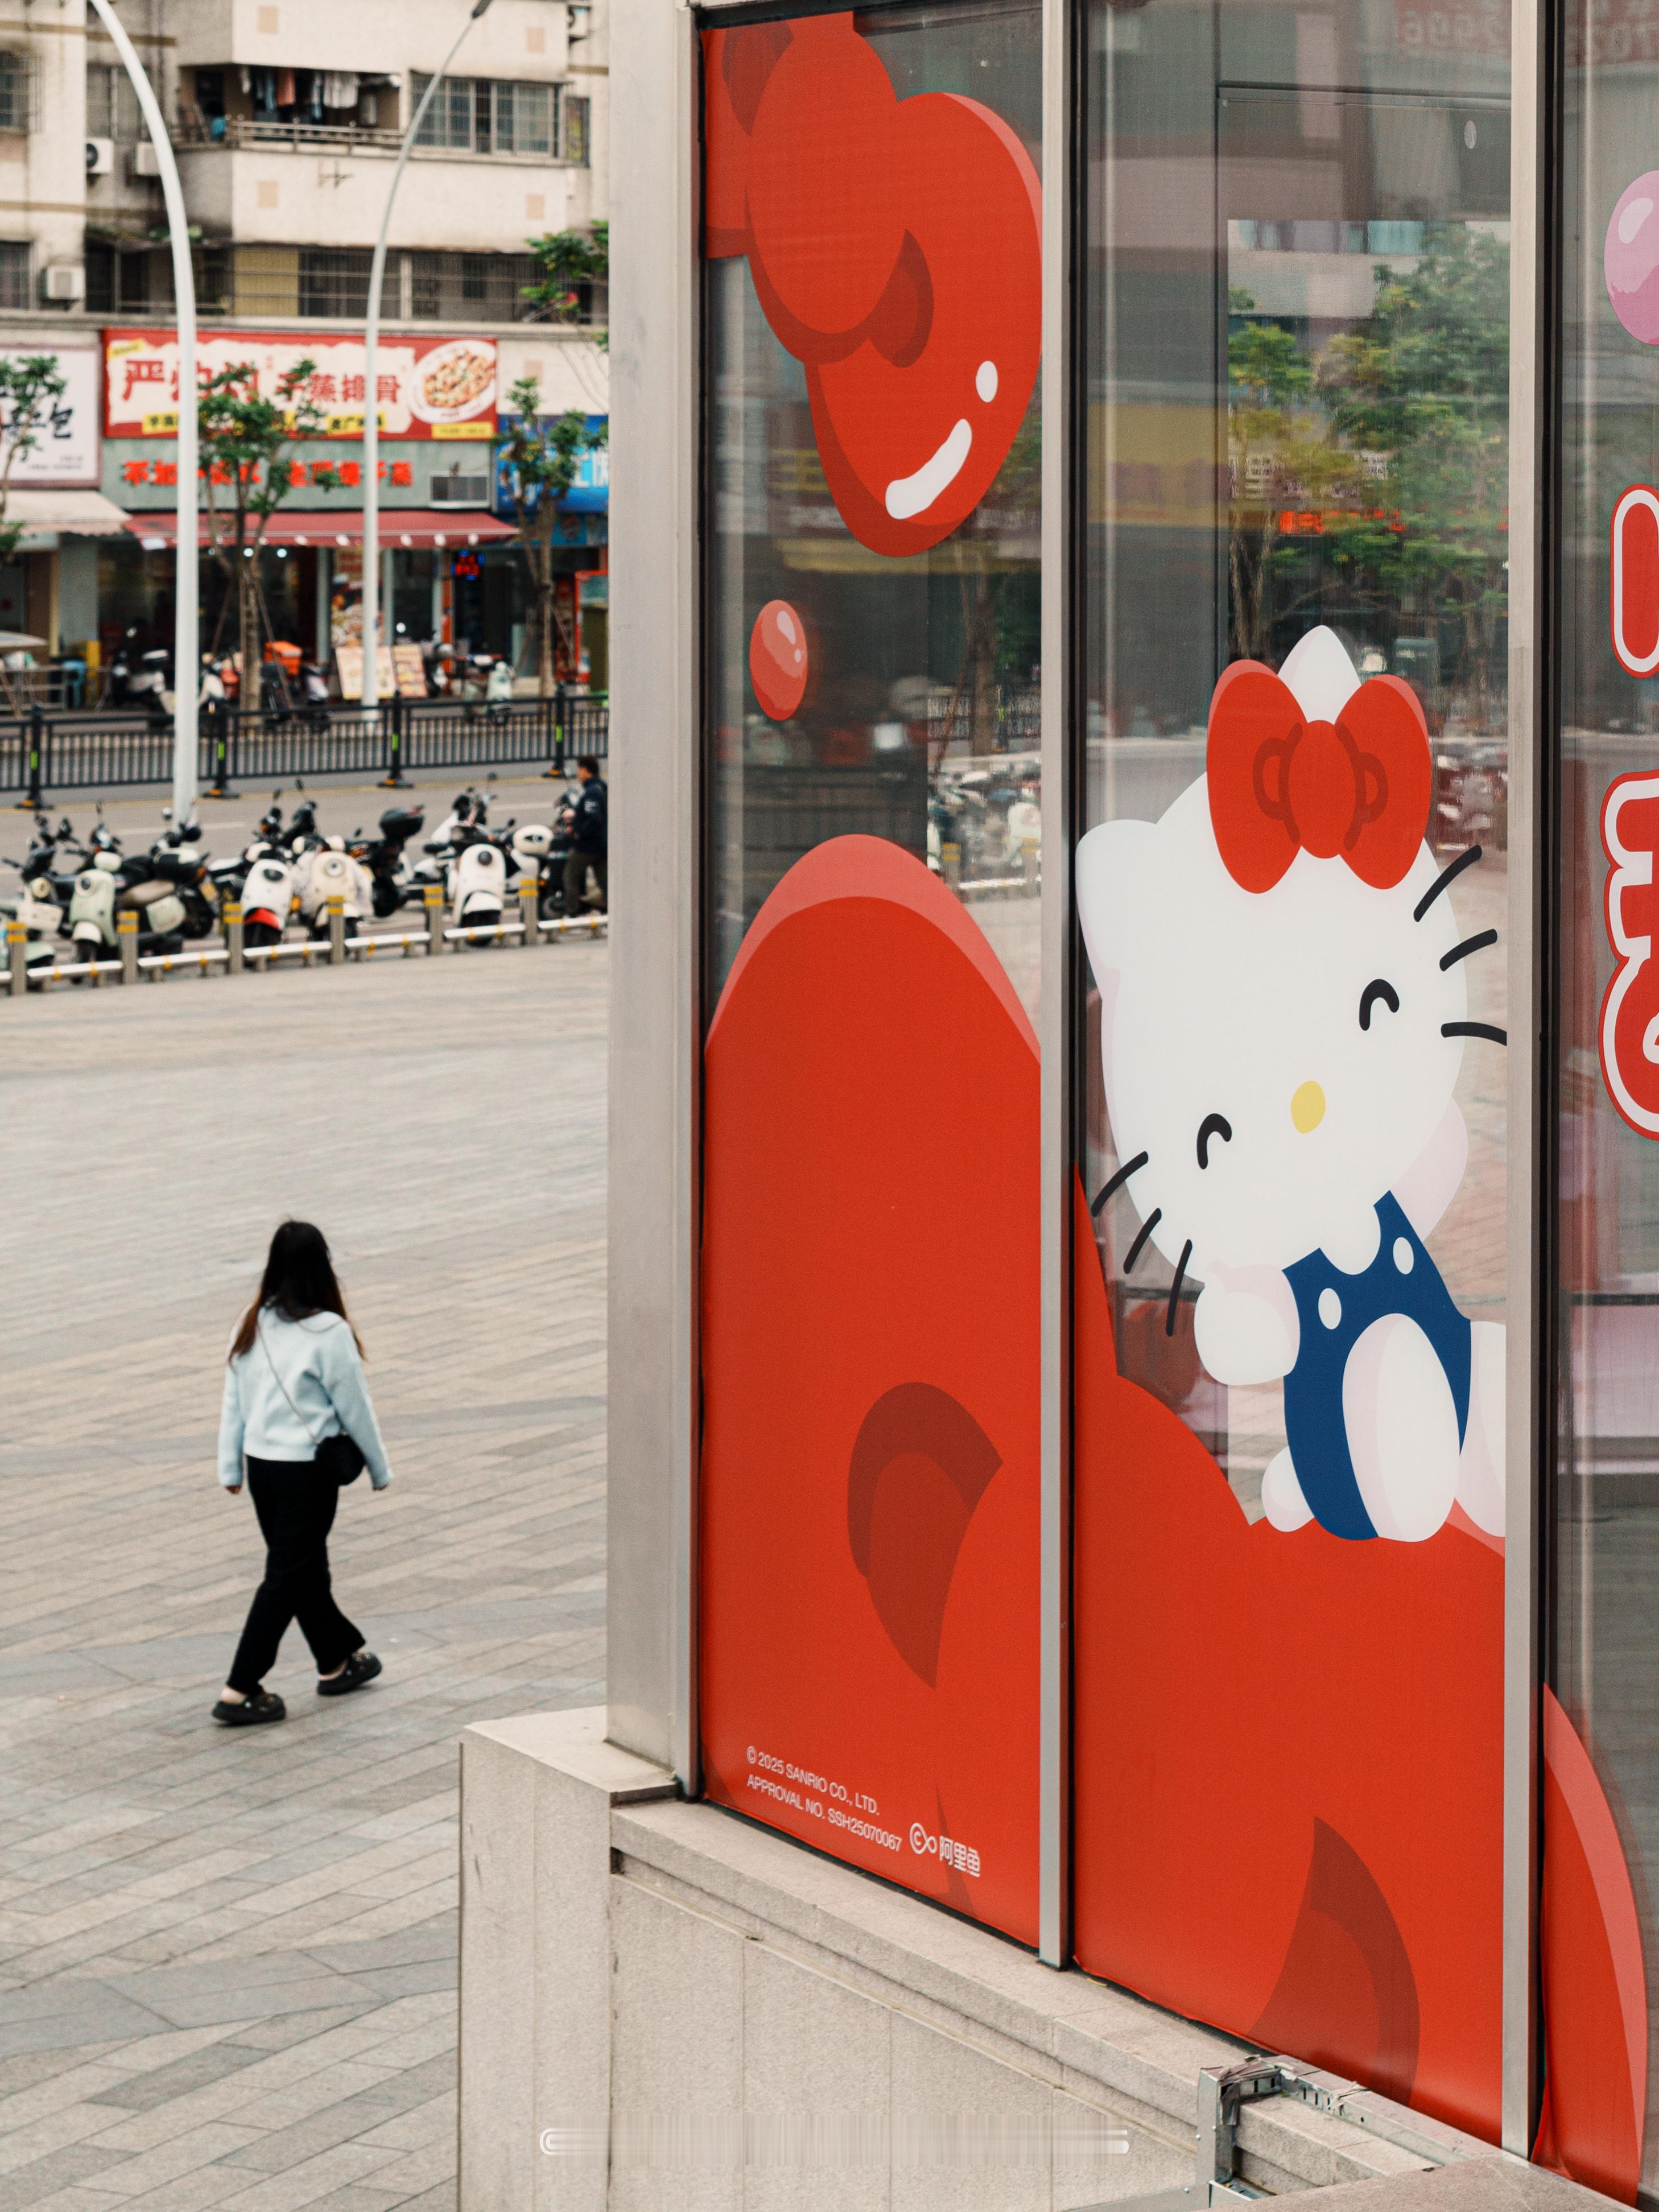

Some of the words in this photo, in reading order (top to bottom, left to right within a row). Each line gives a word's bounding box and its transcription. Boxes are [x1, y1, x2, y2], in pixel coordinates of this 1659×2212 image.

[746, 1774, 804, 1810] APPROVAL
[806, 1798, 826, 1819] NO.
[827, 1807, 902, 1851] SSH25070067
[758, 1751, 785, 1774] 2025
[786, 1763, 827, 1793] SANRIO
[829, 1782, 853, 1806] CO.,
[855, 1792, 880, 1815] LTD.
[939, 1835, 981, 1877] 阿里鱼
